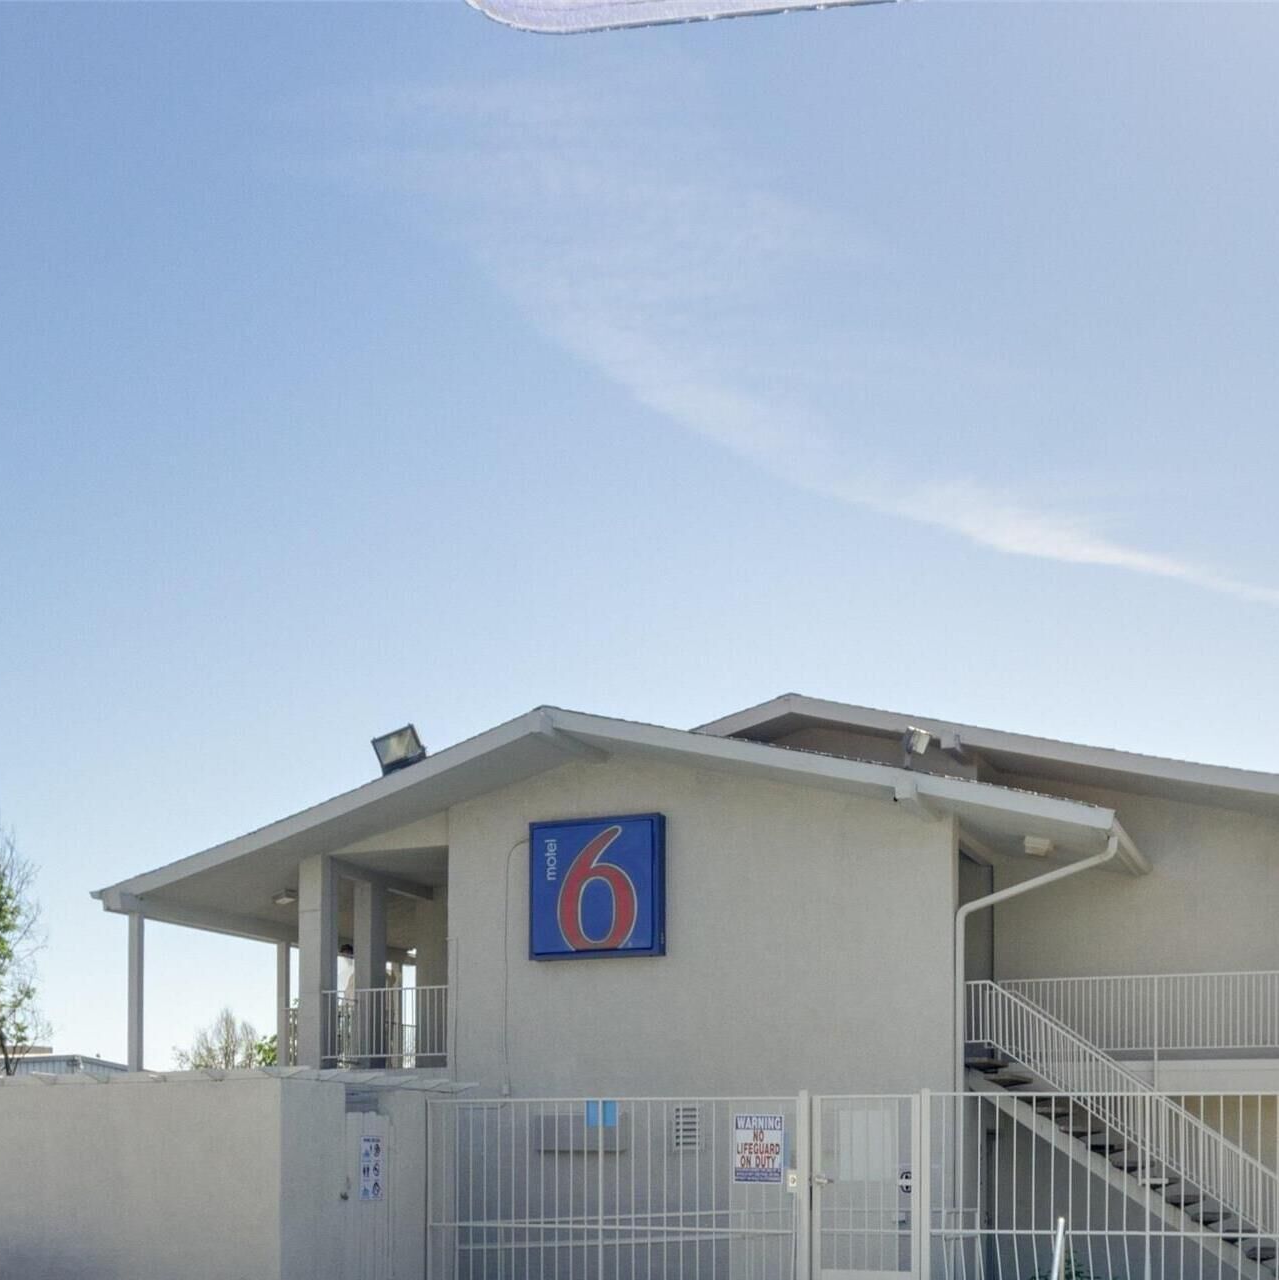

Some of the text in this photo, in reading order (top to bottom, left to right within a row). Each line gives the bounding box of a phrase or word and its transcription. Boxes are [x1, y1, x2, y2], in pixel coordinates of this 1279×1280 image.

[544, 839, 558, 880] motel
[557, 825, 638, 951] 6
[736, 1116, 781, 1130] WARNING
[753, 1130, 764, 1142] NO
[736, 1143, 781, 1155] LIFEGUARD
[740, 1155, 777, 1168] ON DUTY
